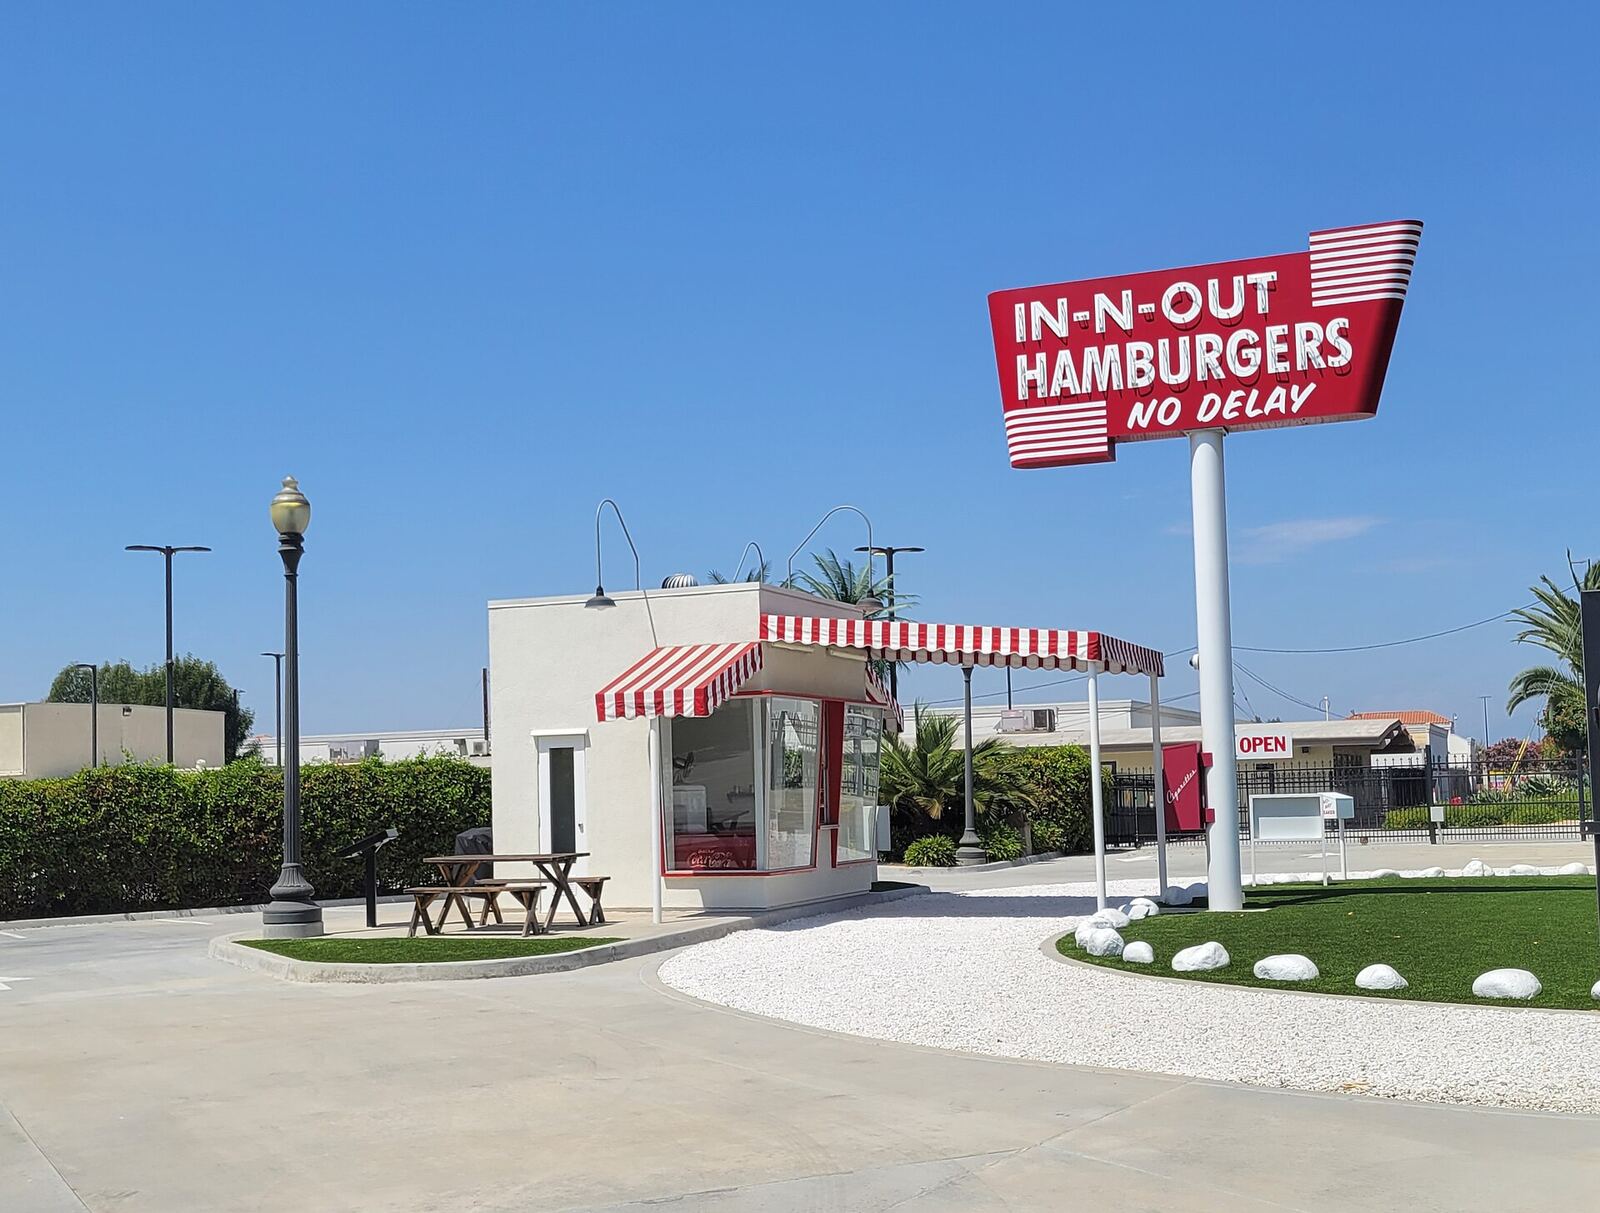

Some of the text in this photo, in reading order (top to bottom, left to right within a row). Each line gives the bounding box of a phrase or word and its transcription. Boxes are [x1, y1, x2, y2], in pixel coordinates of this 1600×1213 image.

[1014, 271, 1278, 343] IN-N-OUT
[1016, 318, 1353, 400] HAMBURGERS
[1126, 382, 1317, 429] NO DELAY
[1239, 736, 1286, 753] OPEN
